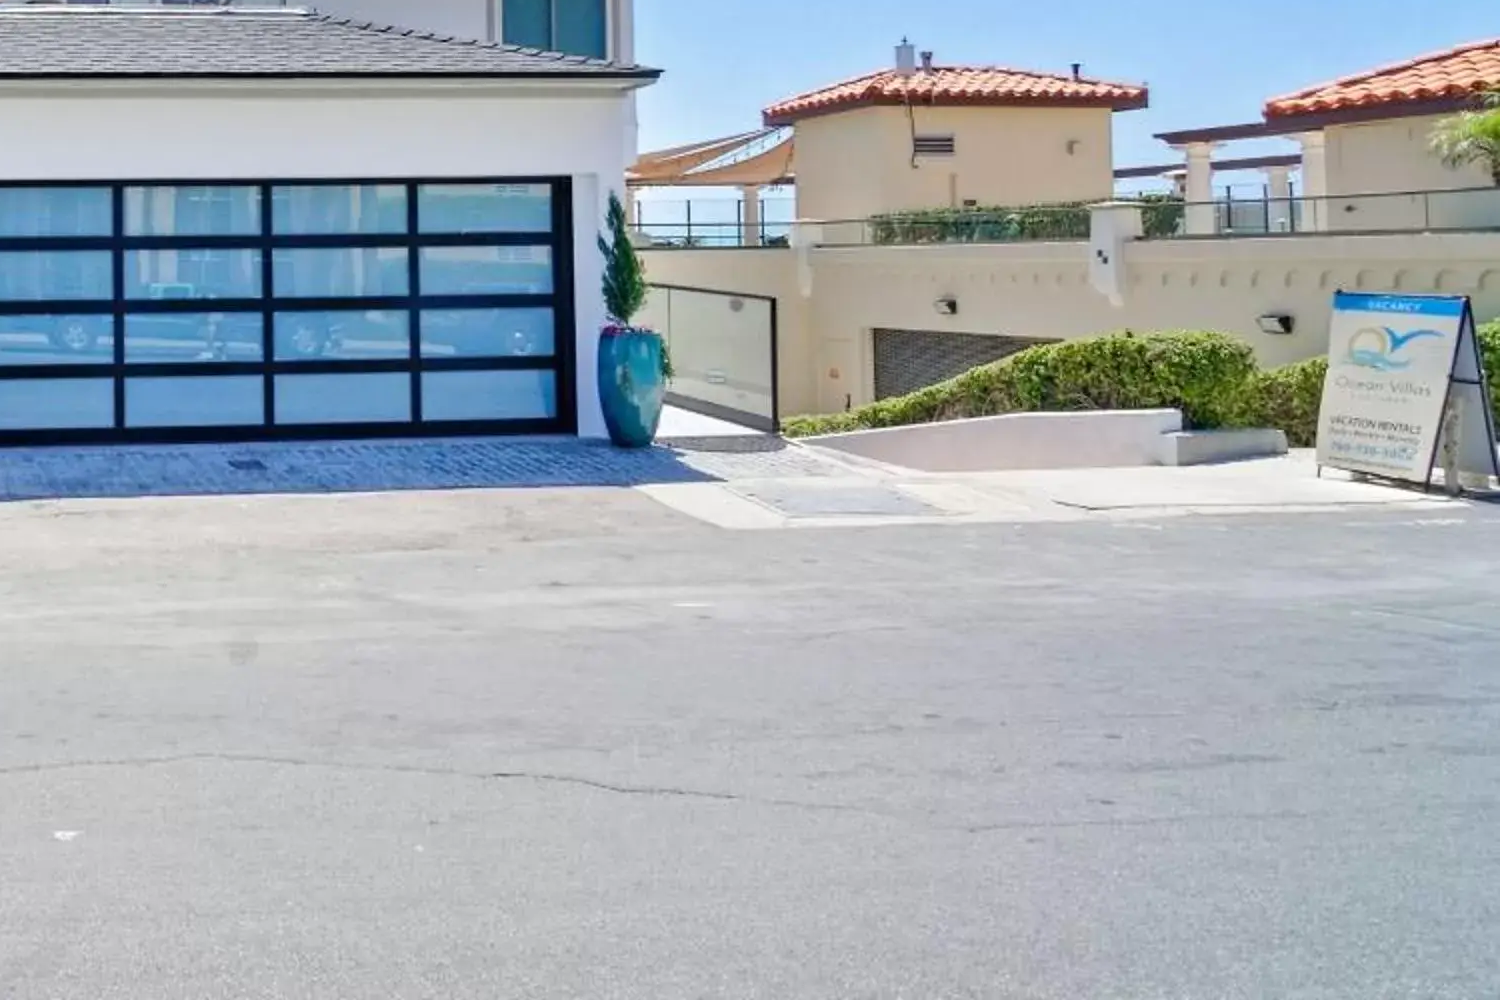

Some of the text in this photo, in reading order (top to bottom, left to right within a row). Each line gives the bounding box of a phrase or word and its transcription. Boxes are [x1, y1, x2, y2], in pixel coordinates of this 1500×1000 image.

[1367, 300, 1422, 313] VACANCY
[1335, 374, 1431, 397] Ocean Villas
[1329, 415, 1422, 435] VACATION RENTALS
